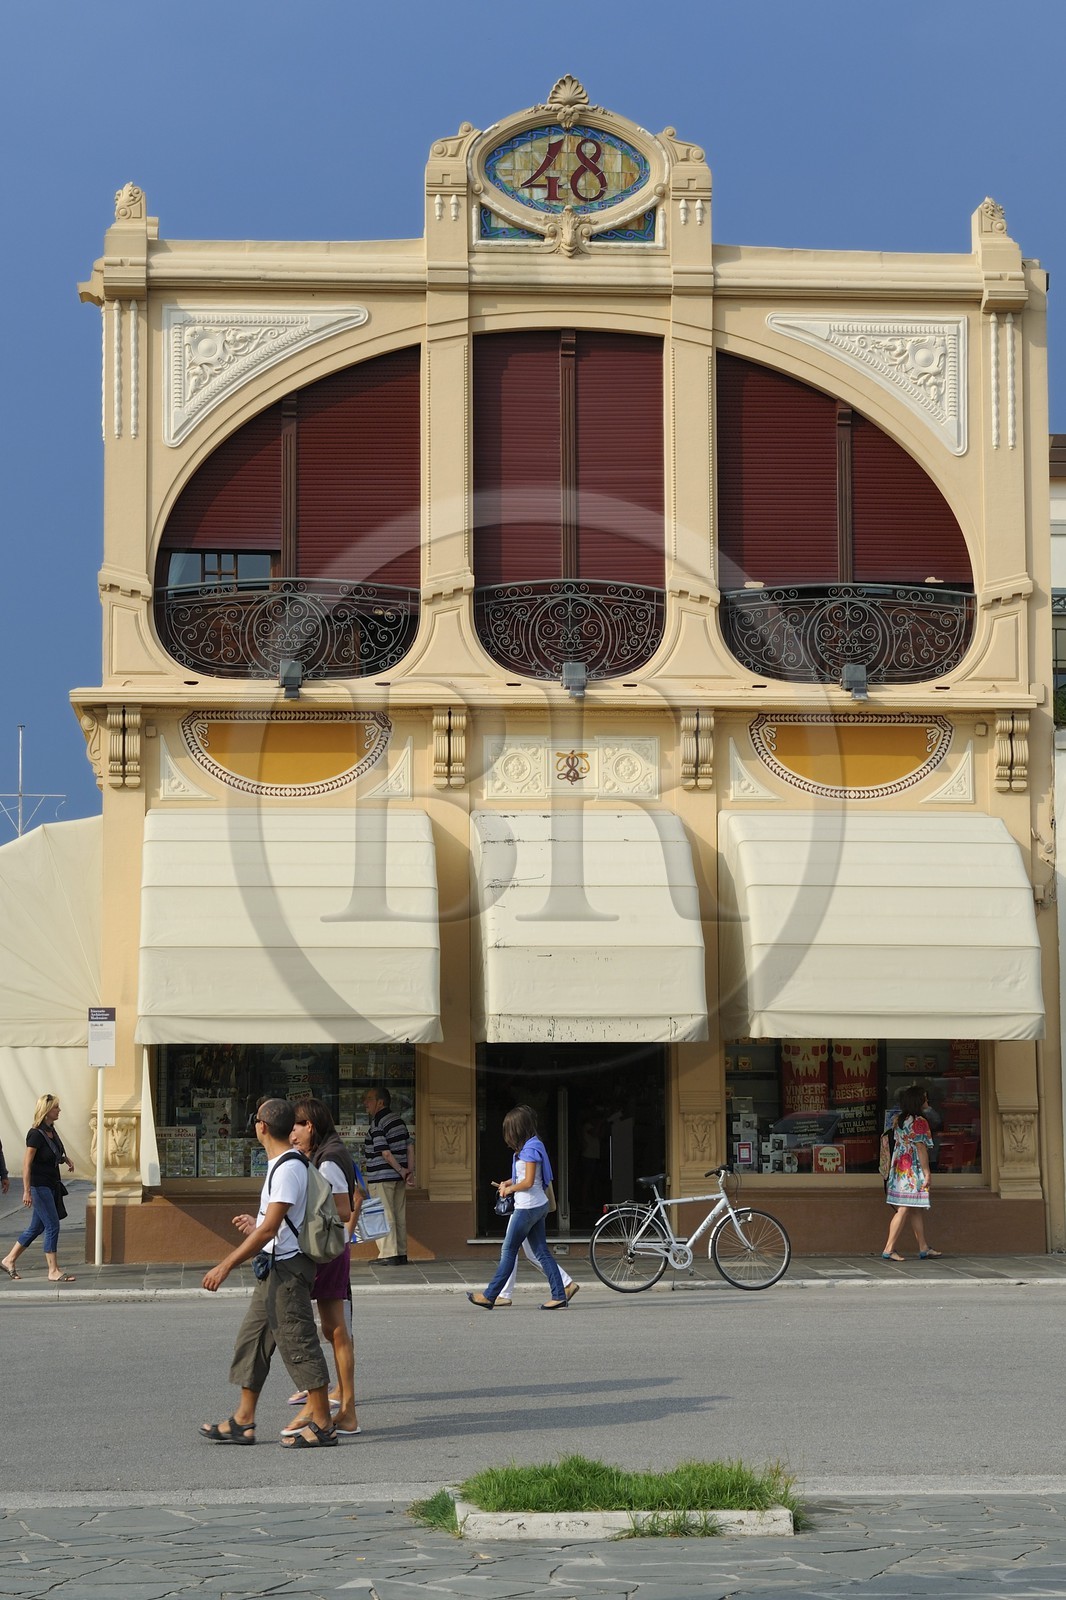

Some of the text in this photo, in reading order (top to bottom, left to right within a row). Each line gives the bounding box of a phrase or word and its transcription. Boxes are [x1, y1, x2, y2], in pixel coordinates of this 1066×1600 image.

[520, 138, 608, 202] 48
[785, 1083, 826, 1096] VINCERE
[836, 1088, 877, 1099] RESISTERE
[786, 1095, 803, 1104] NON
[793, 1103, 826, 1112] CHIMERA
